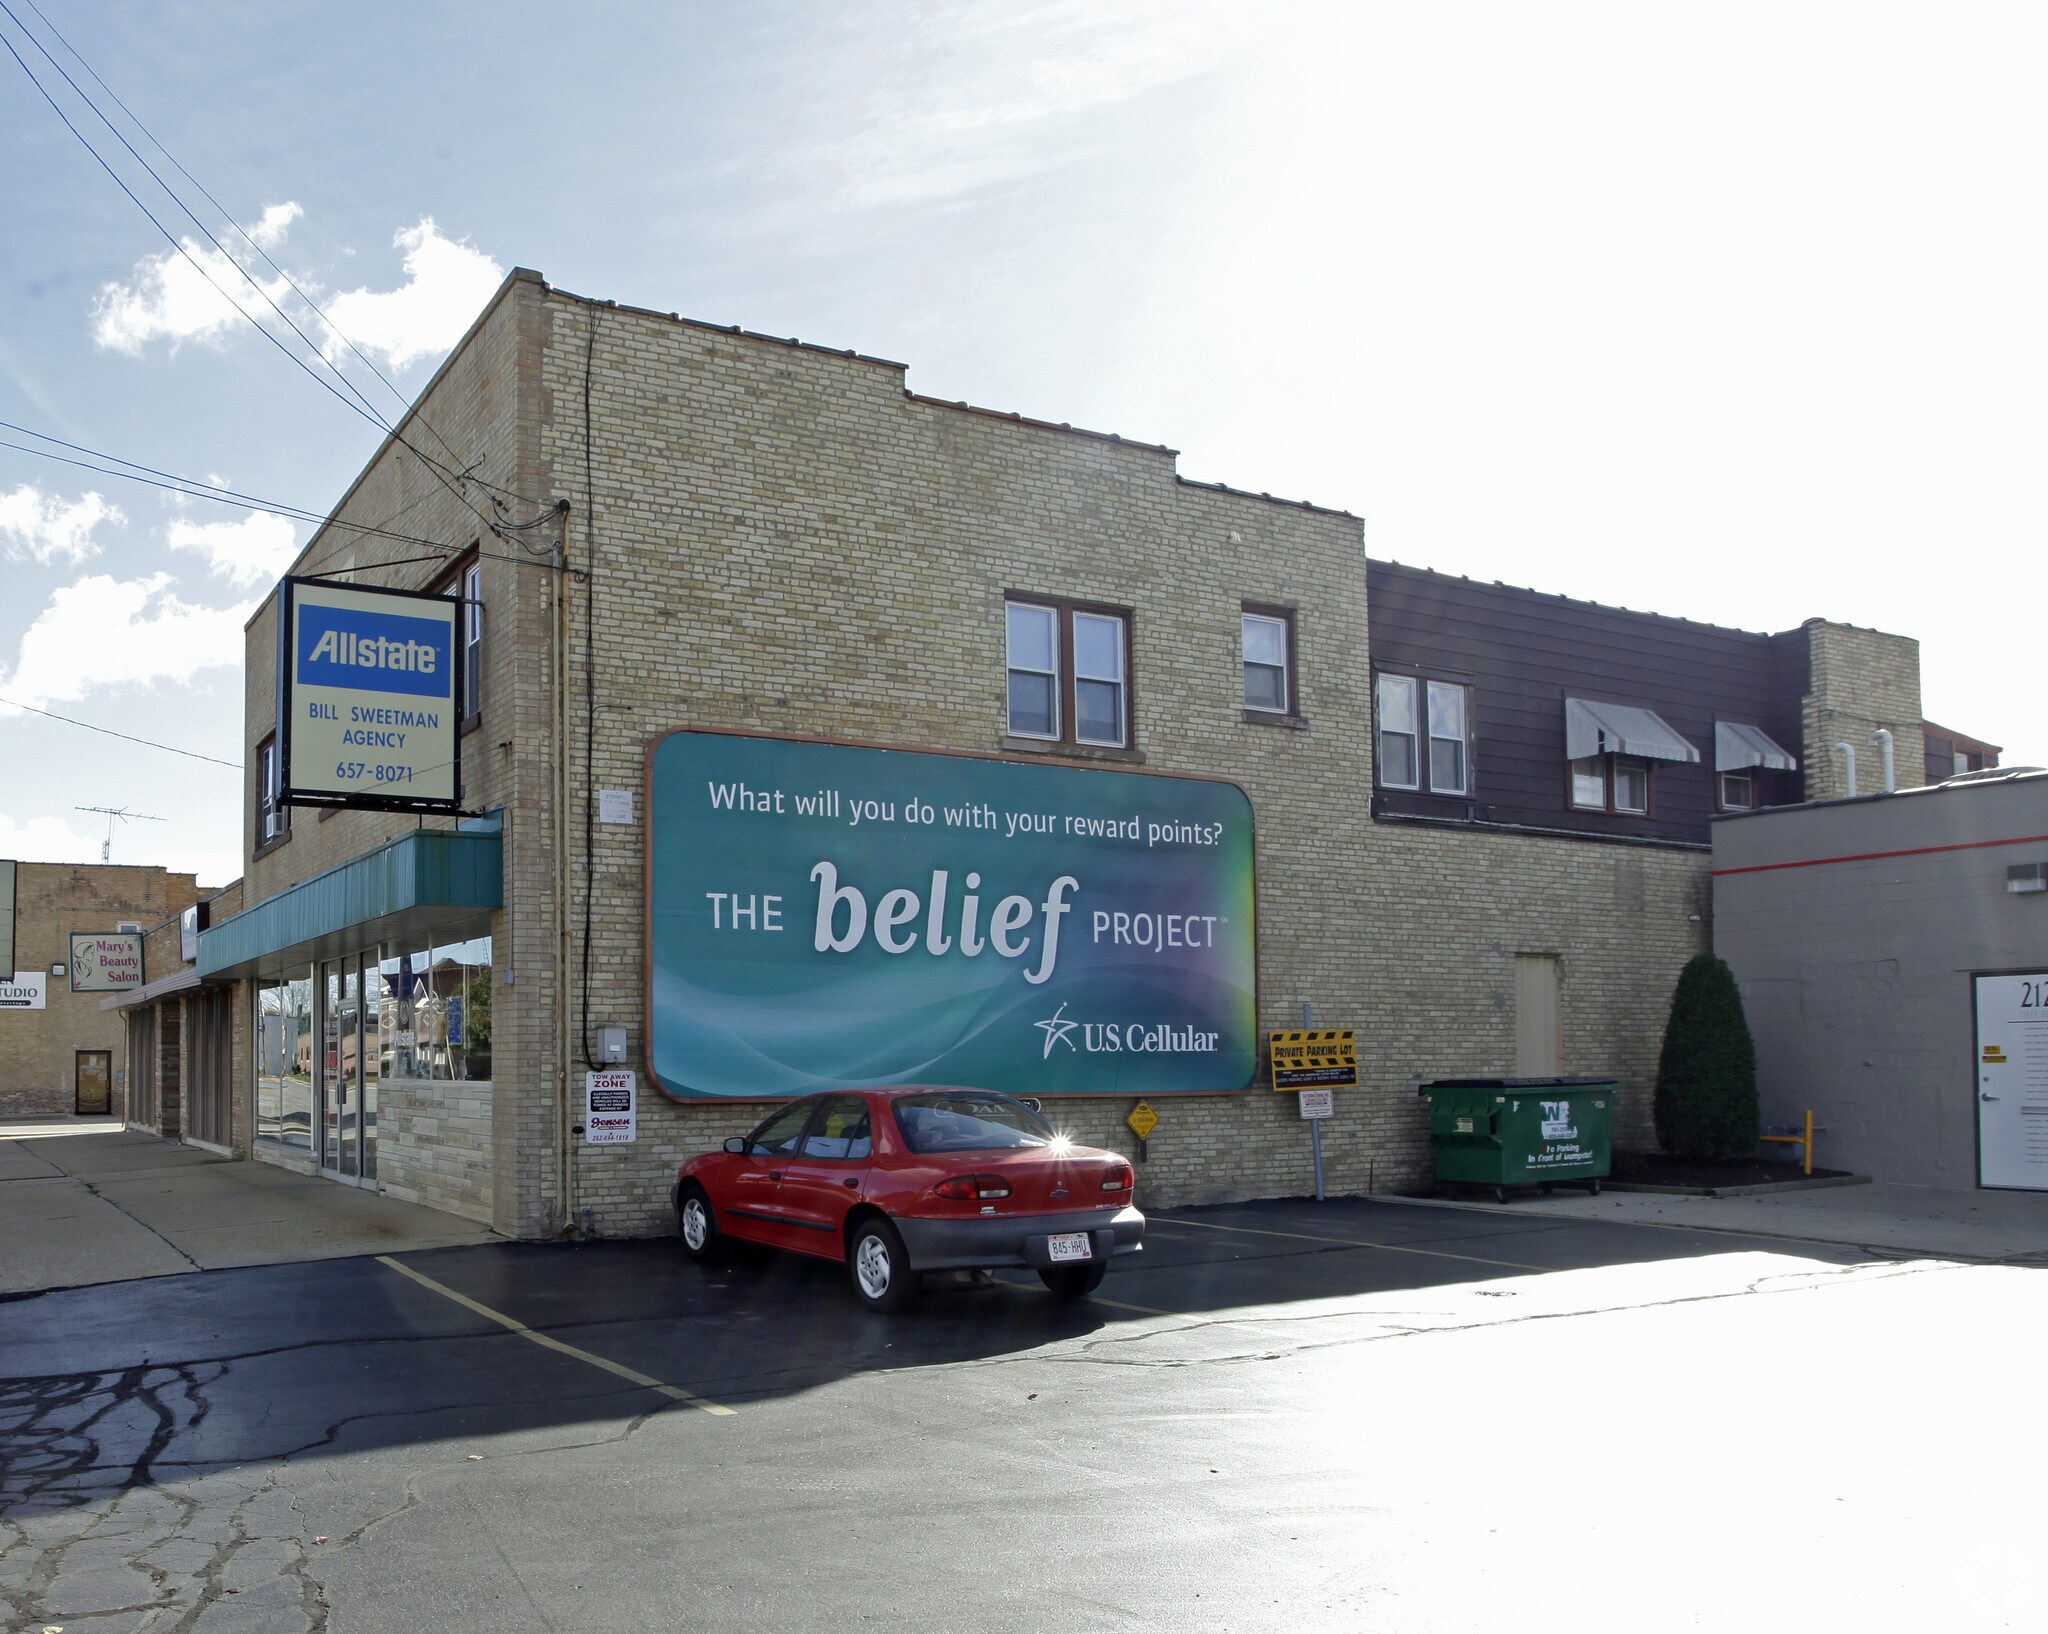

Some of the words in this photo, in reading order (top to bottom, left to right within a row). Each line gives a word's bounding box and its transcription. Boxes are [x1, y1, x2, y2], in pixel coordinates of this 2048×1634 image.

[309, 630, 436, 674] Allstate
[309, 702, 339, 721] BILL
[351, 706, 438, 729] SWEETMAN
[343, 729, 406, 748] AGENCY
[336, 762, 412, 782] 657-8071
[709, 782, 785, 814] What
[795, 790, 840, 817] will
[849, 798, 895, 826] you
[905, 797, 935, 824] do
[944, 802, 997, 829] with
[1005, 811, 1056, 837] your
[1065, 815, 1140, 840] reward
[1149, 820, 1223, 847] points?
[706, 892, 784, 931] THE
[810, 861, 1079, 984] belief
[1093, 911, 1217, 953] PROJECT
[96, 940, 133, 954] Mary's
[100, 955, 138, 968] Beauty
[107, 970, 139, 982] Salon
[1083, 1023, 1124, 1052] U.S.
[1126, 1023, 1218, 1052] Cellular
[1274, 1046, 1304, 1058] PRIVATE
[1306, 1044, 1337, 1056] PARKING
[1340, 1043, 1352, 1055] LOT
[594, 1080, 627, 1088] ZONE
[1556, 1143, 1580, 1153] Parking
[1052, 1239, 1087, 1255] 845-HHU
